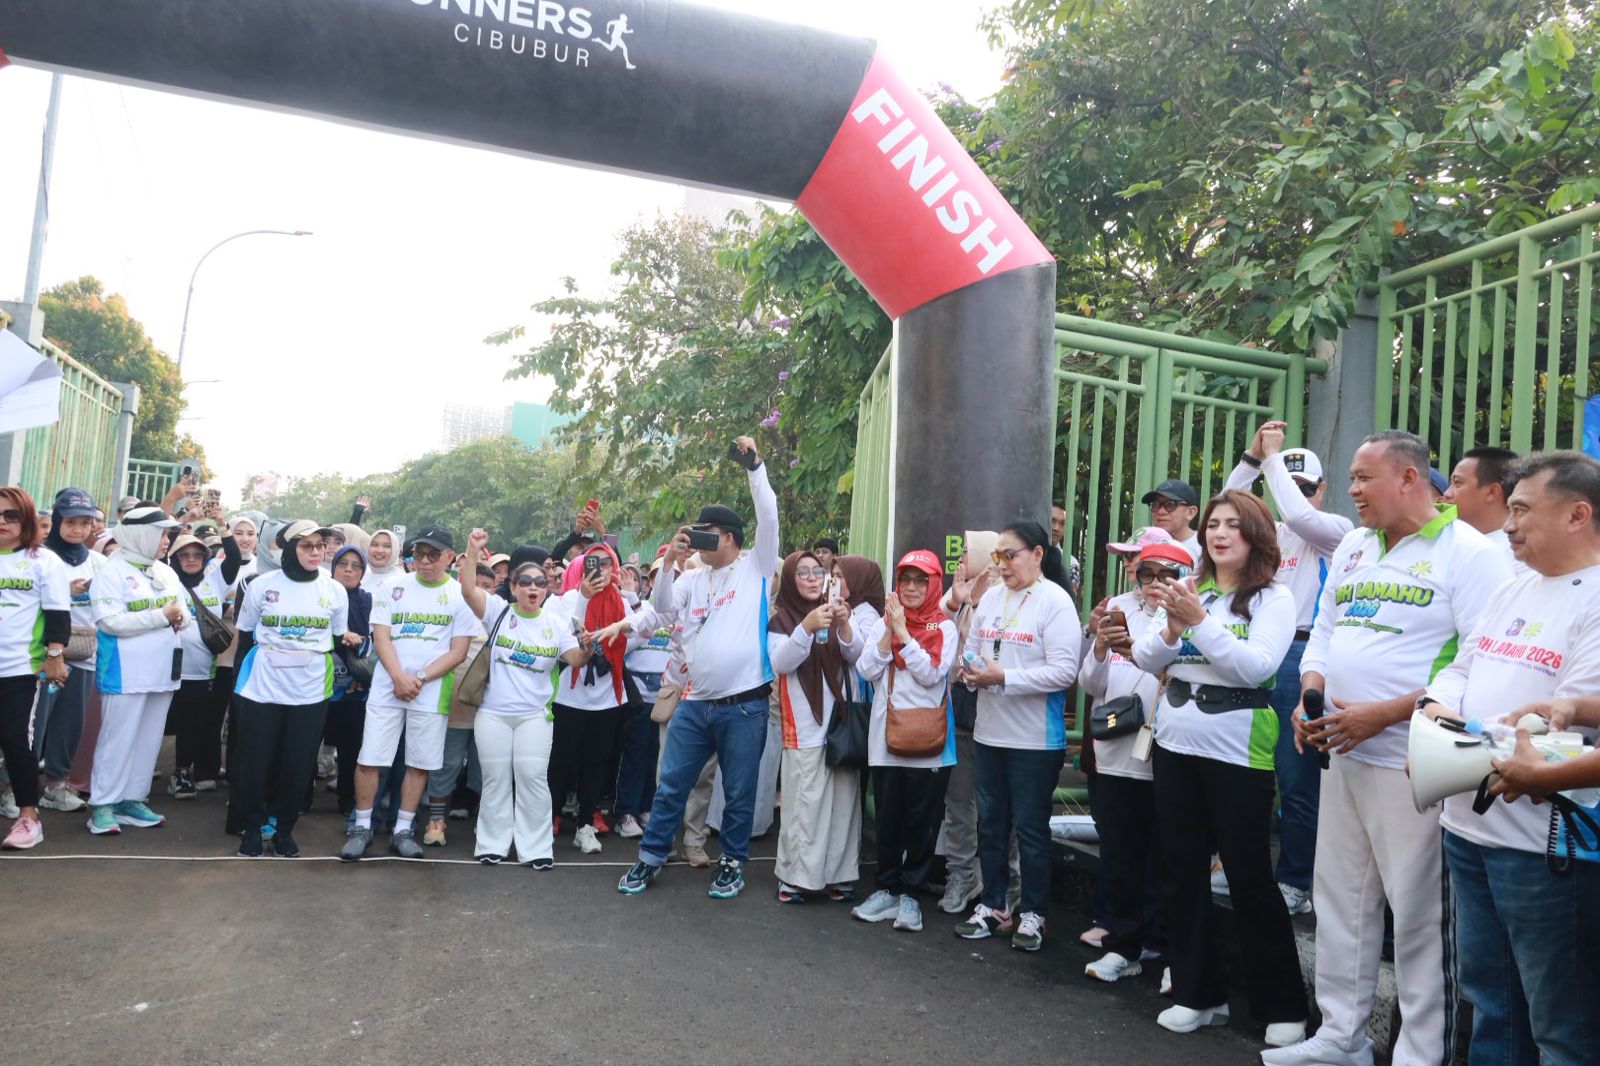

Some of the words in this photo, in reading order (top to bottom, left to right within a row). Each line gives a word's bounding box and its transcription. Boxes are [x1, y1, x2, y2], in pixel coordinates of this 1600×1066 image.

[408, 0, 593, 39] NNERS
[453, 23, 590, 68] CIBUBUR
[851, 87, 1014, 275] FINISH
[1355, 581, 1434, 607] LAMAHU
[404, 612, 453, 627] LAMAHU
[514, 640, 558, 658] LAMAHU
[1491, 640, 1528, 659] LAMAHU
[1526, 646, 1563, 670] 2026
